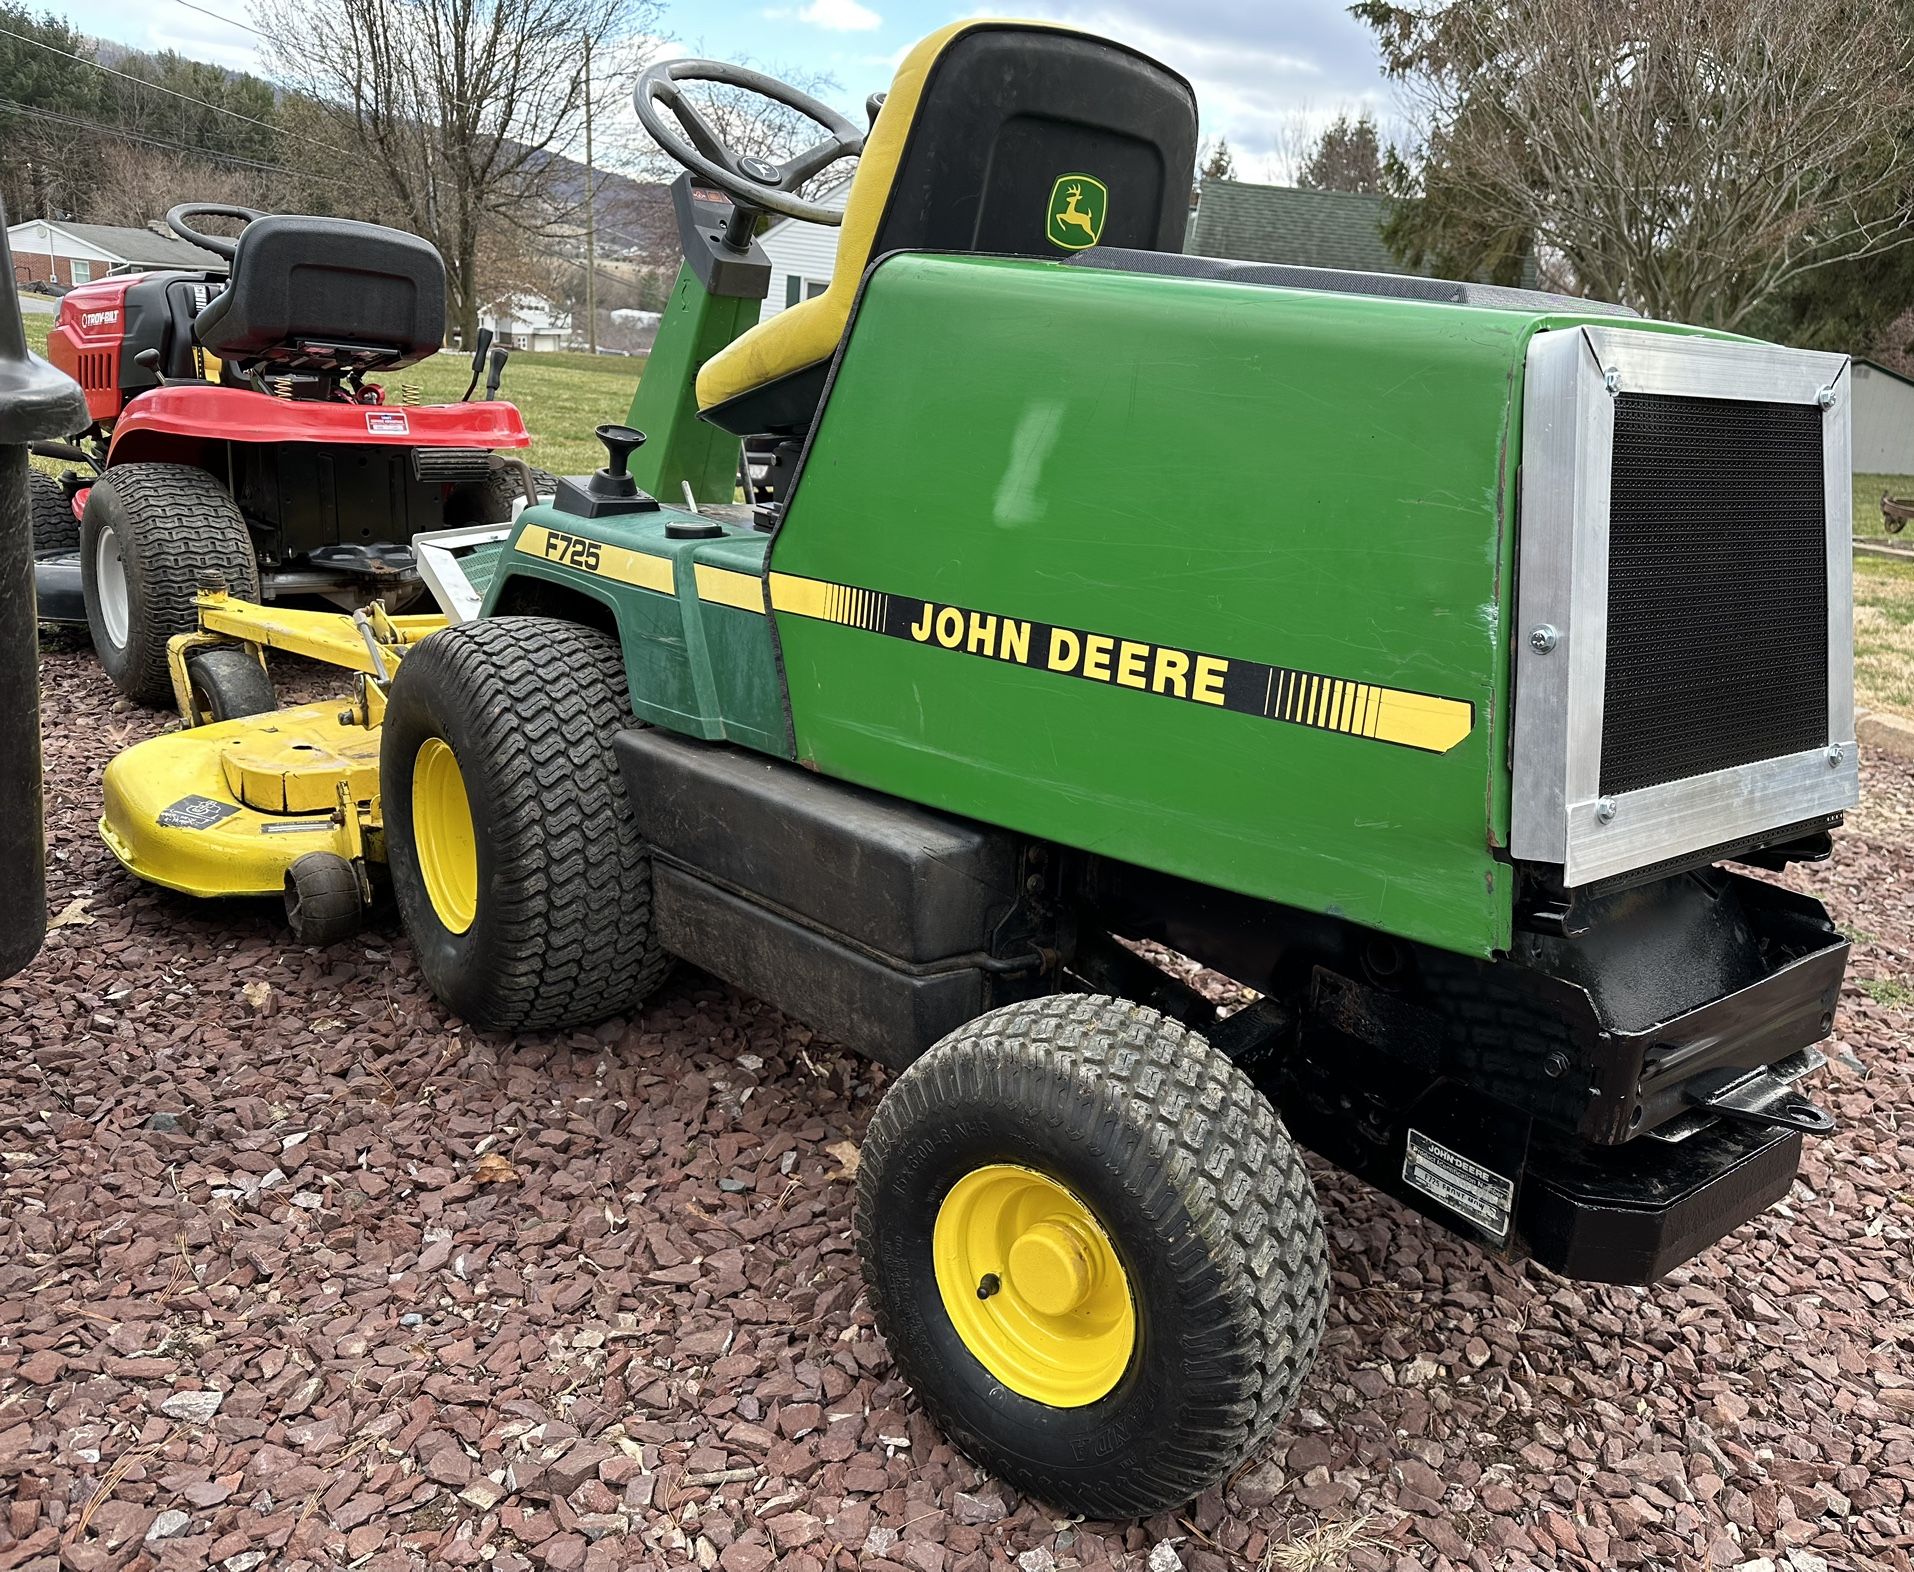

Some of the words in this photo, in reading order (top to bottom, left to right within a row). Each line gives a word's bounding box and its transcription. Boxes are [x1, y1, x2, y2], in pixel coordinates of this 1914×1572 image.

[87, 310, 119, 326] TROY-BILT
[545, 531, 601, 571] F725
[911, 603, 1031, 664] JOHN
[1047, 627, 1229, 706] DEERE
[1413, 1146, 1436, 1164] Product
[1428, 1144, 1455, 1164] JOHN
[1454, 1158, 1490, 1182] DEERE
